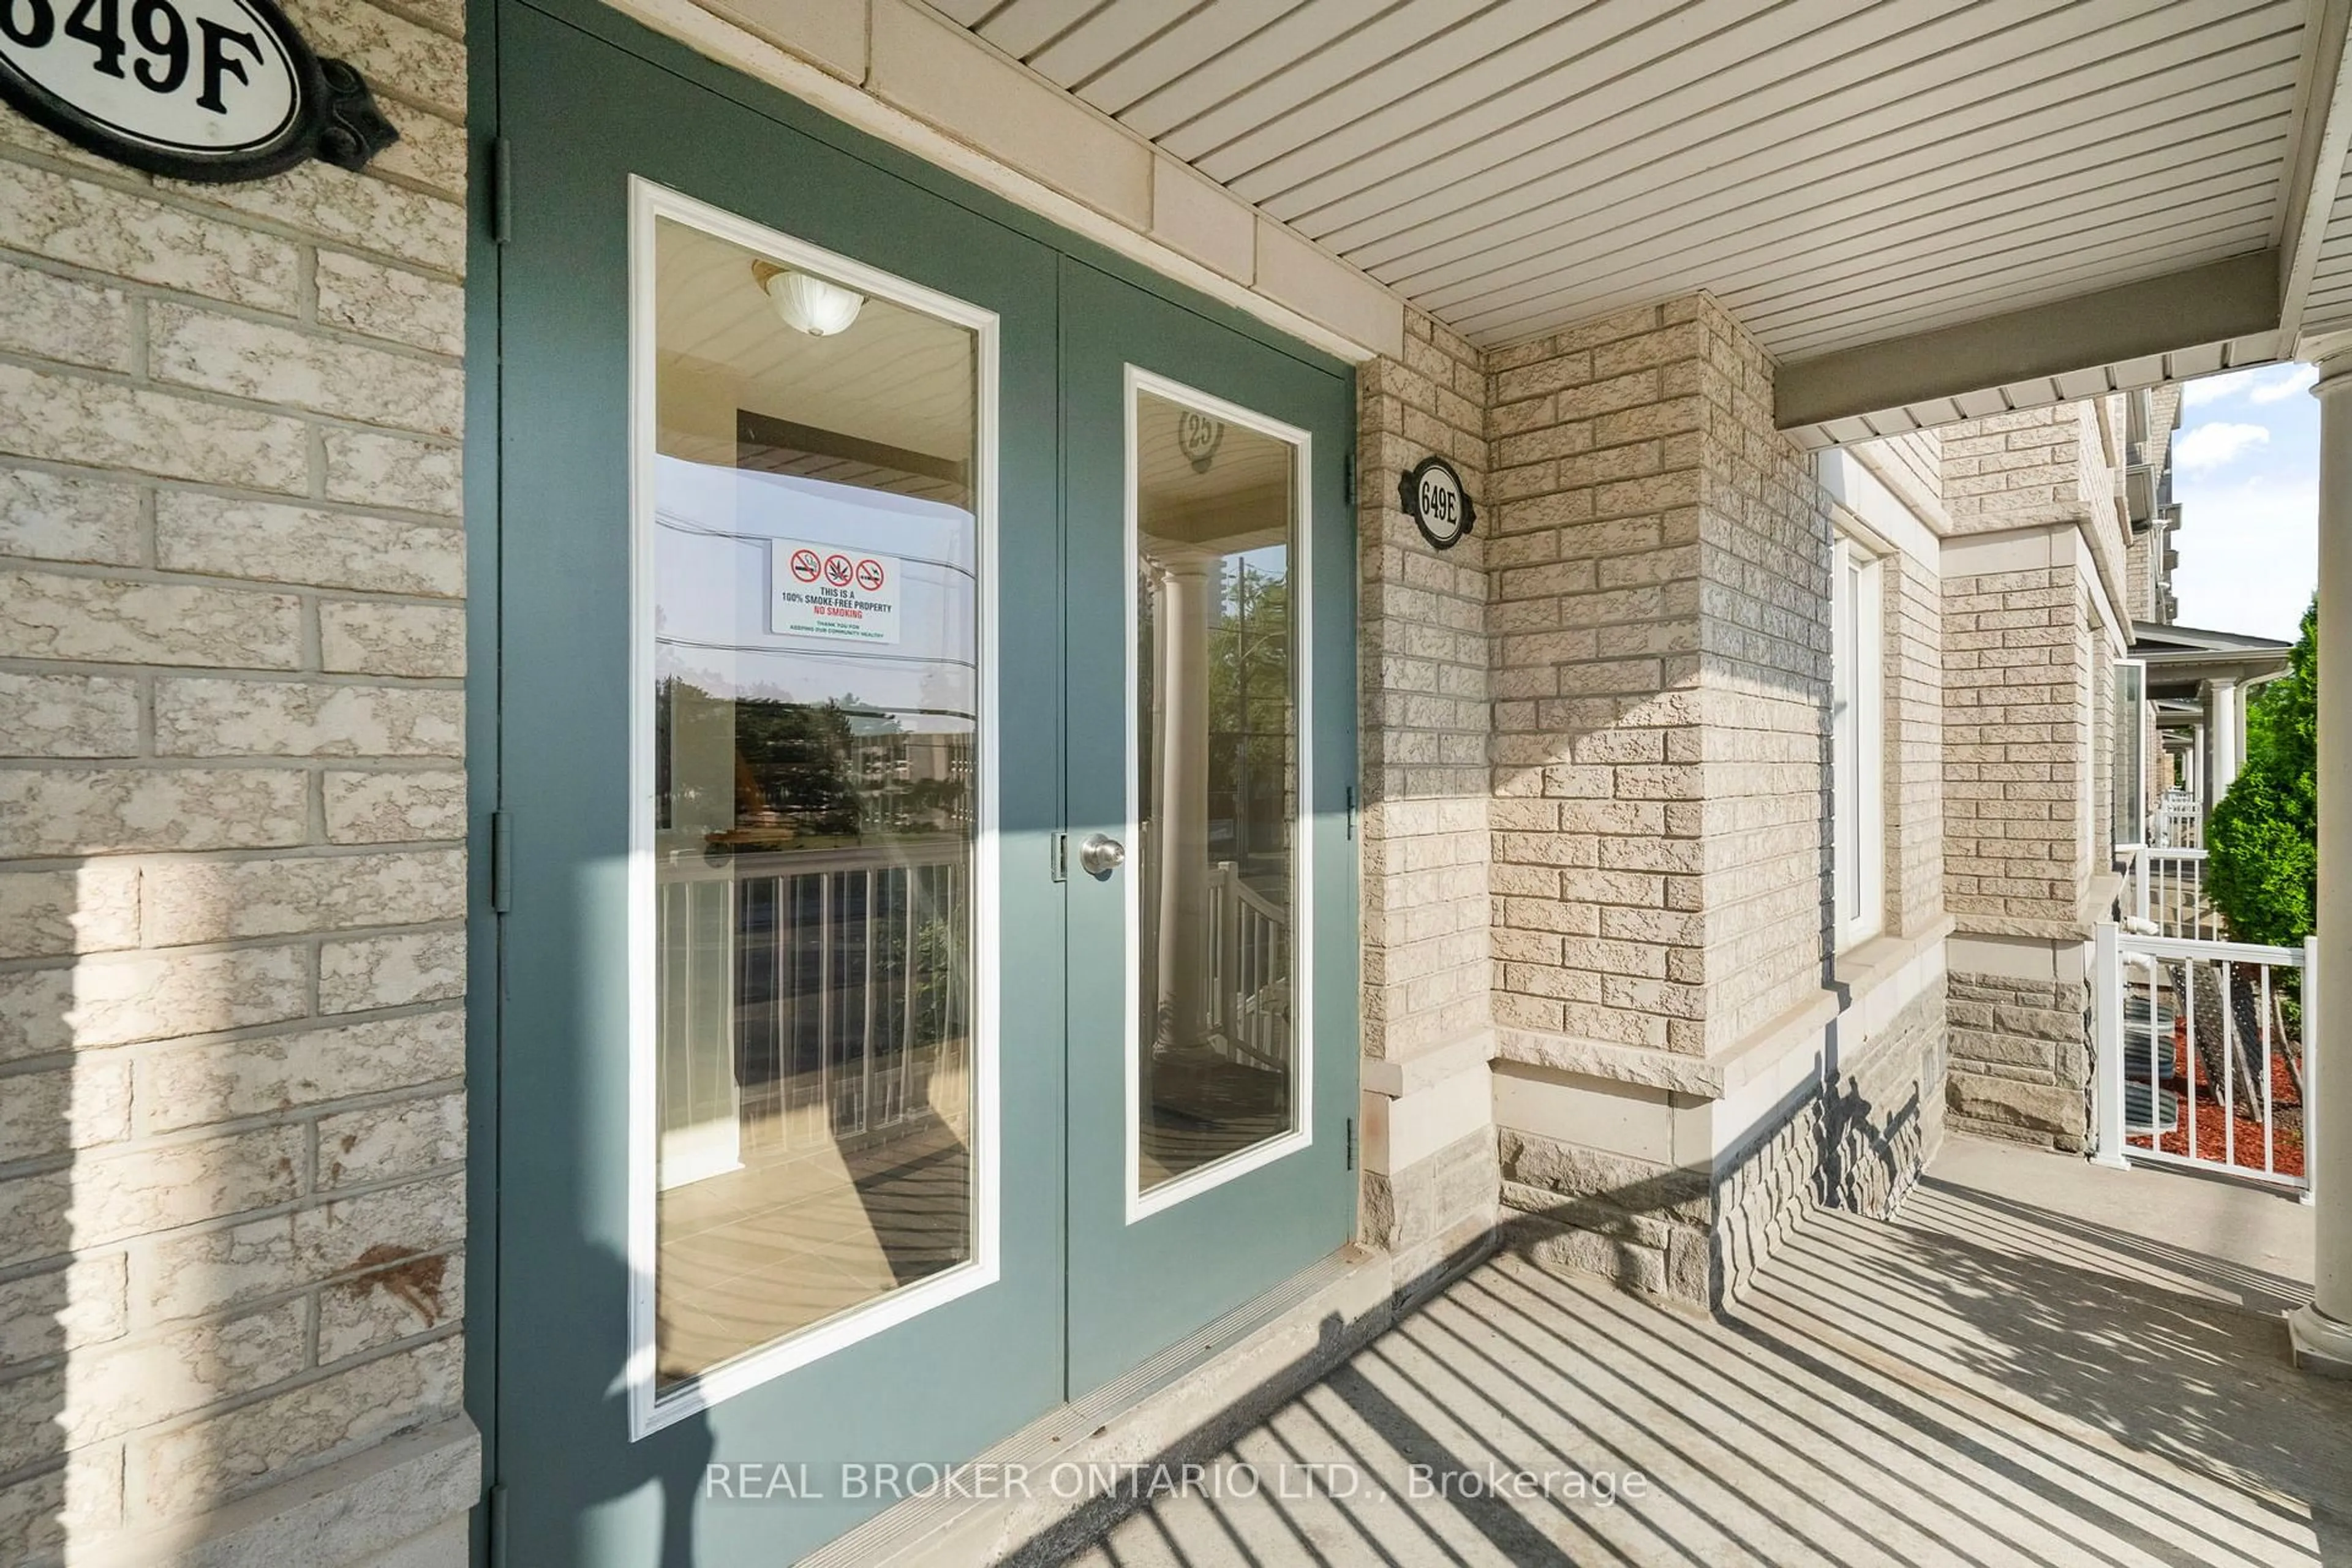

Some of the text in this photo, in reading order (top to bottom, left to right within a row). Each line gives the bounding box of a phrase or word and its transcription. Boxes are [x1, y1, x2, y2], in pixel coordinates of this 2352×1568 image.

[1422, 481, 1457, 526] 649E
[820, 587, 855, 599] THIS IS A
[782, 592, 892, 612] 100% SMOKE-FREE PROPERTY
[814, 606, 862, 619] NO SMOKING
